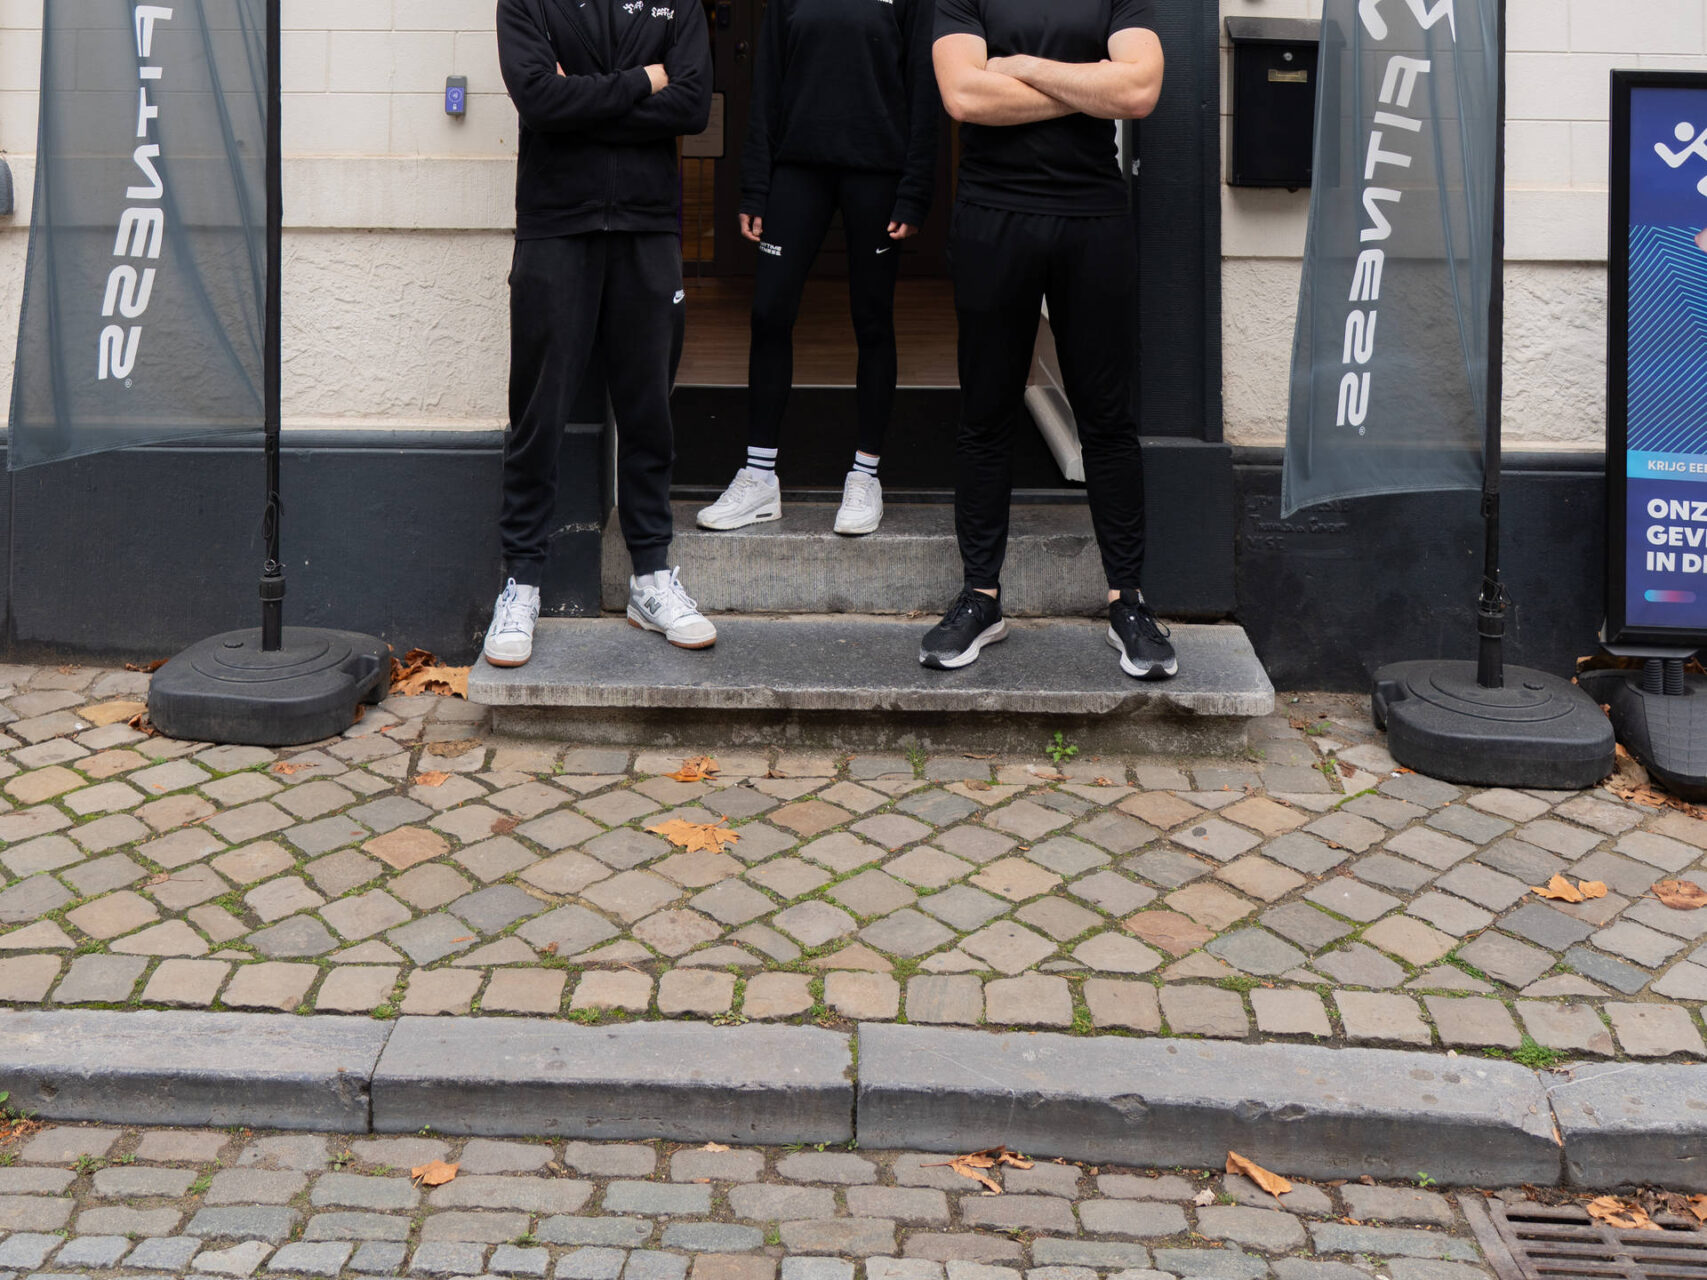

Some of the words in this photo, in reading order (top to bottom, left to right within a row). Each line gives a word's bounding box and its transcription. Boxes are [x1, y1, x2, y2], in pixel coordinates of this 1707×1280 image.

[1647, 459, 1686, 473] KRIJG
[1689, 462, 1707, 474] EE
[1646, 524, 1707, 548] GEV
[1646, 551, 1676, 572] IN
